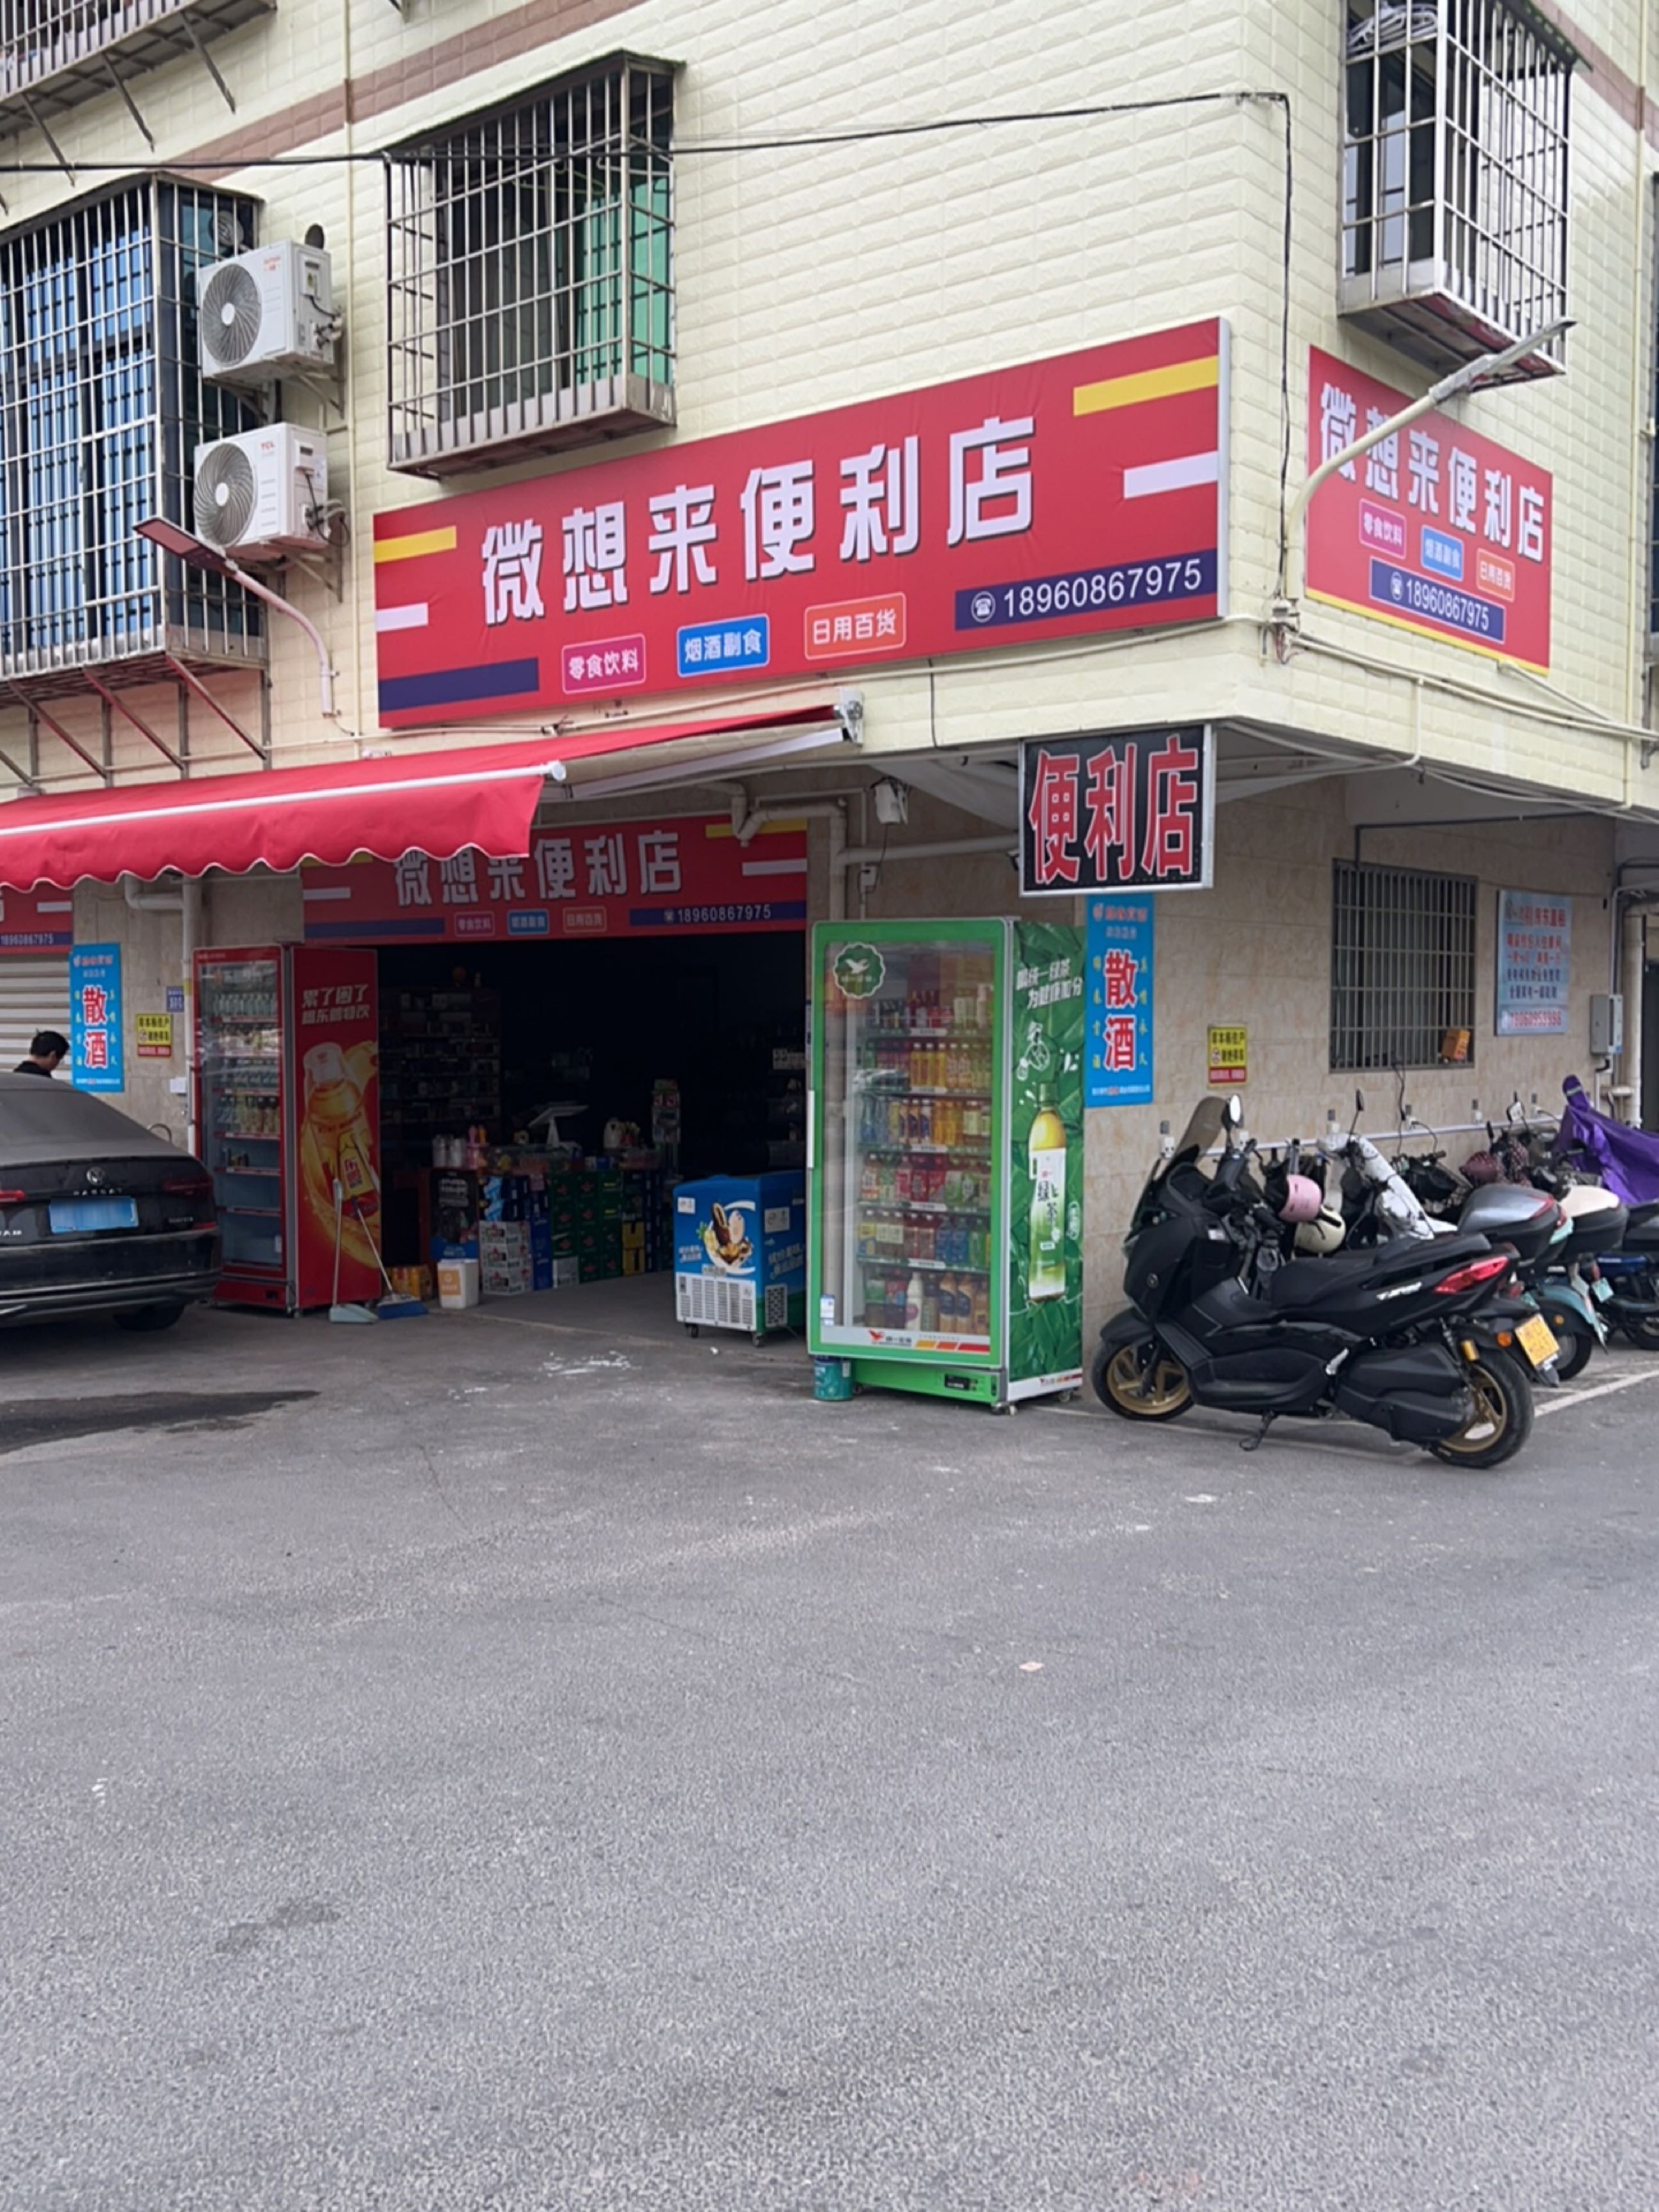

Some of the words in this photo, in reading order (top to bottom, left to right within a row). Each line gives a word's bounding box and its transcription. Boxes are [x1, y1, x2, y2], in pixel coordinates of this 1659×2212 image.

[1320, 383, 1544, 563] 微想来便利店
[481, 416, 1036, 627] 微想来便利店
[1363, 512, 1402, 547] 零食饮料
[1004, 559, 1202, 618] 18960867975
[1406, 579, 1489, 630] 18960867975
[684, 629, 762, 664] 烟酒副食
[813, 609, 897, 645] 日用百货
[568, 650, 639, 680] 零食饮料
[1028, 734, 1198, 885] 便利店
[394, 830, 682, 907] 微想来便利店
[677, 904, 771, 923] 18960867975
[302, 984, 369, 1008] 累了困了
[1027, 977, 1083, 1009] 为健康加分
[1103, 948, 1139, 1072] 散酒
[83, 984, 108, 1070] 散酒
